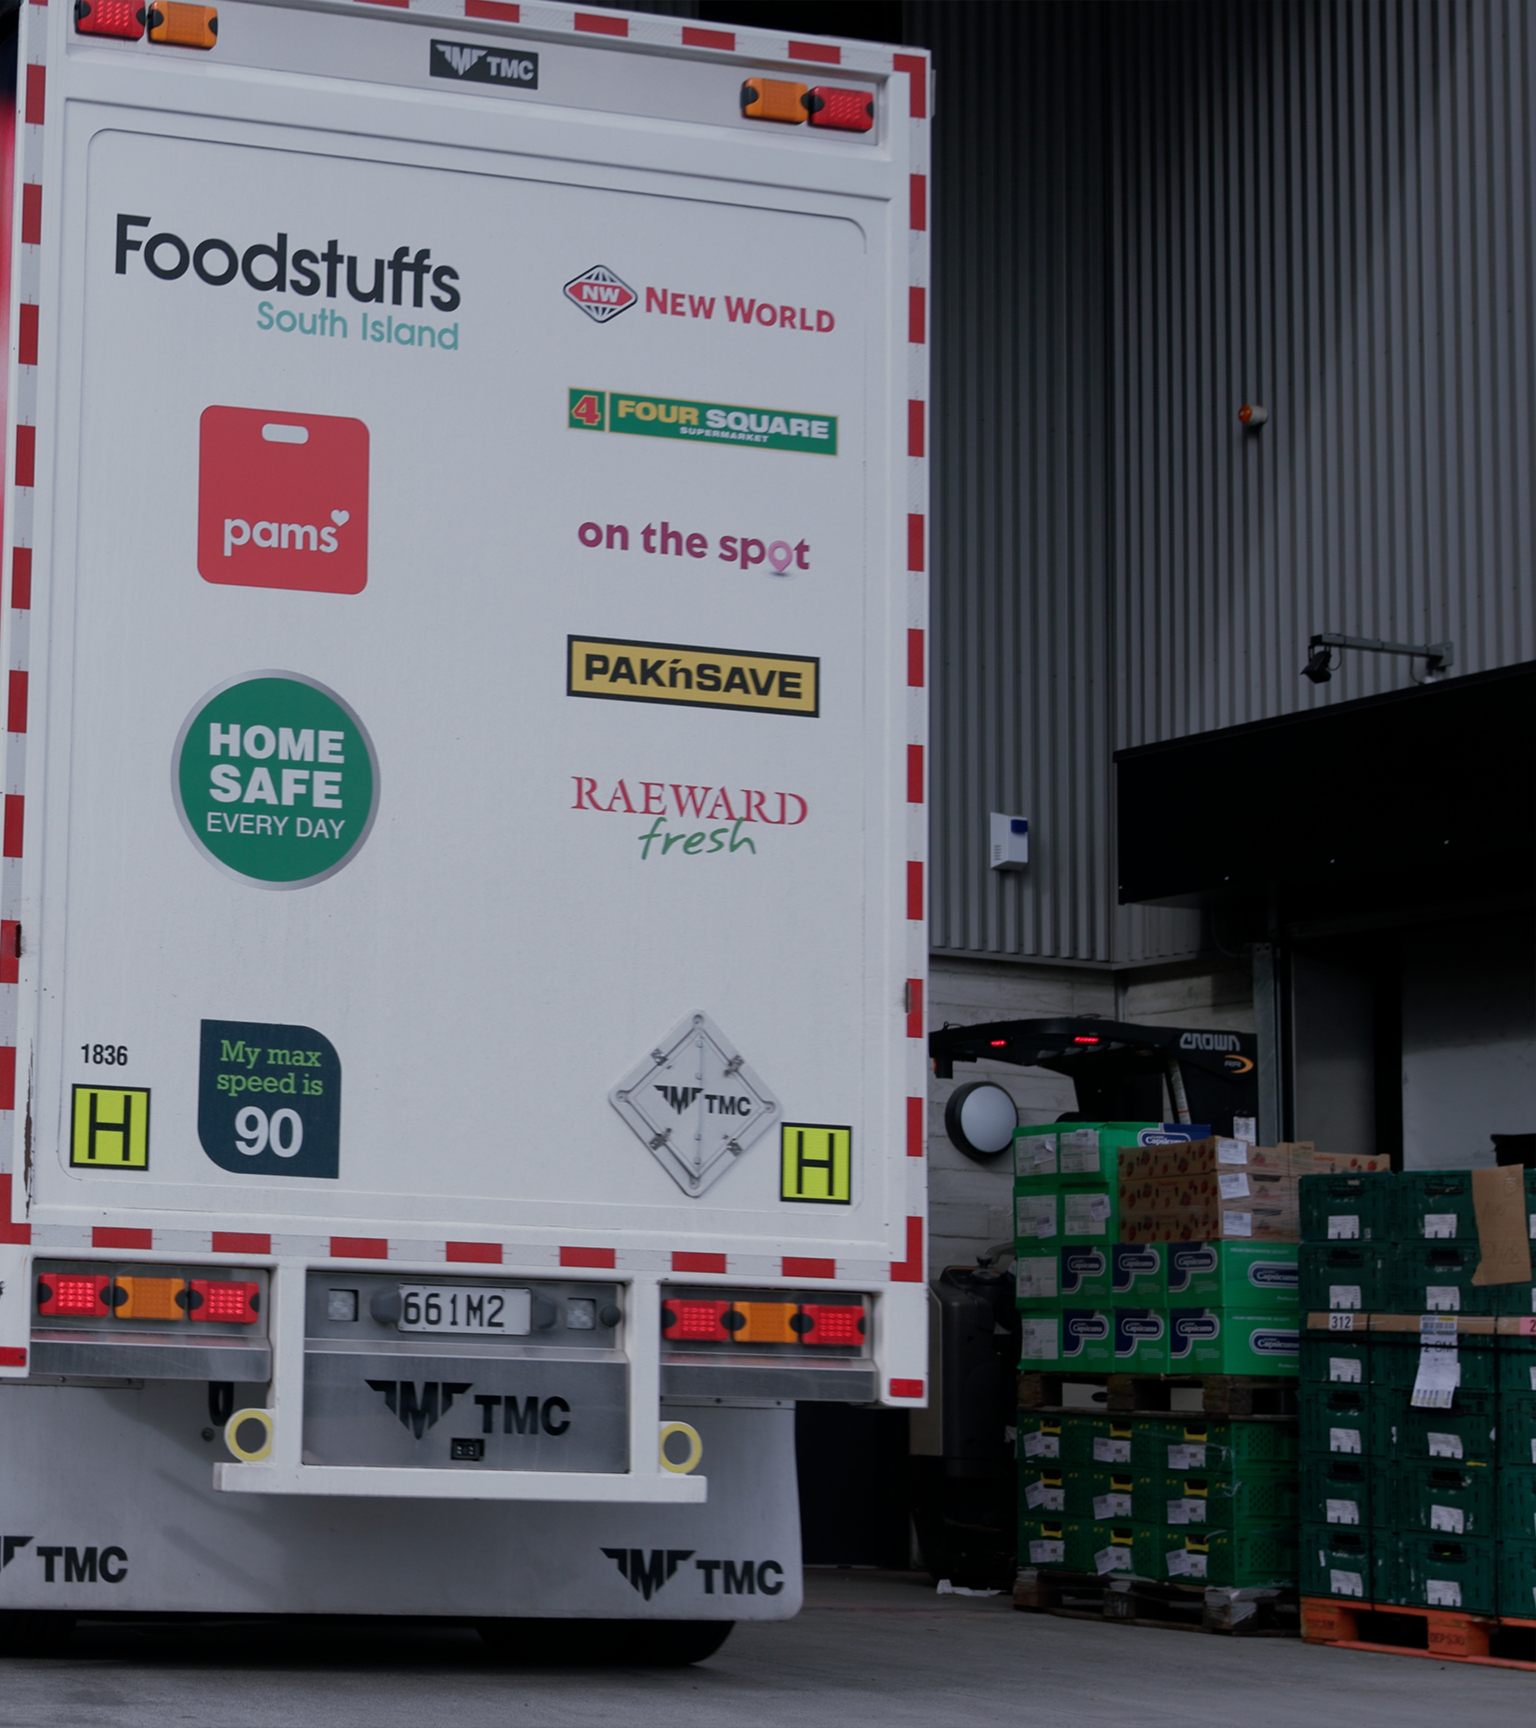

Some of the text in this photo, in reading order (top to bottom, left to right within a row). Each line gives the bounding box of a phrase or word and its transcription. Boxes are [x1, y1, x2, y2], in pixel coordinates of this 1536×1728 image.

[486, 56, 534, 81] TMC
[115, 213, 461, 312] Foodstuffs
[581, 284, 621, 305] NW
[645, 286, 835, 333] NEW WORLD
[256, 301, 459, 351] South Island
[571, 395, 601, 426] 4
[617, 399, 830, 440] FOUR SQUARE
[679, 426, 770, 443] SUPERMARKET
[223, 517, 339, 557] pams
[578, 521, 810, 574] on the spot
[209, 722, 345, 764] HOME
[209, 764, 344, 809] SAFE
[570, 776, 809, 826] RAEWARD
[206, 811, 346, 840] EVERY DAY
[638, 816, 757, 860] fresh
[80, 1043, 129, 1067] 1836
[220, 1040, 322, 1069] My max
[1179, 1031, 1241, 1052] CROWN
[216, 1071, 324, 1097] speed is
[704, 1094, 752, 1117] TMC
[87, 1092, 133, 1162] H
[234, 1105, 303, 1158] 90
[796, 1130, 835, 1197] H
[402, 1291, 505, 1329] 661M2
[1331, 1316, 1351, 1330] 312
[474, 1394, 571, 1437] TMC
[36, 1546, 128, 1584] TMC
[695, 1559, 785, 1596] TMC
